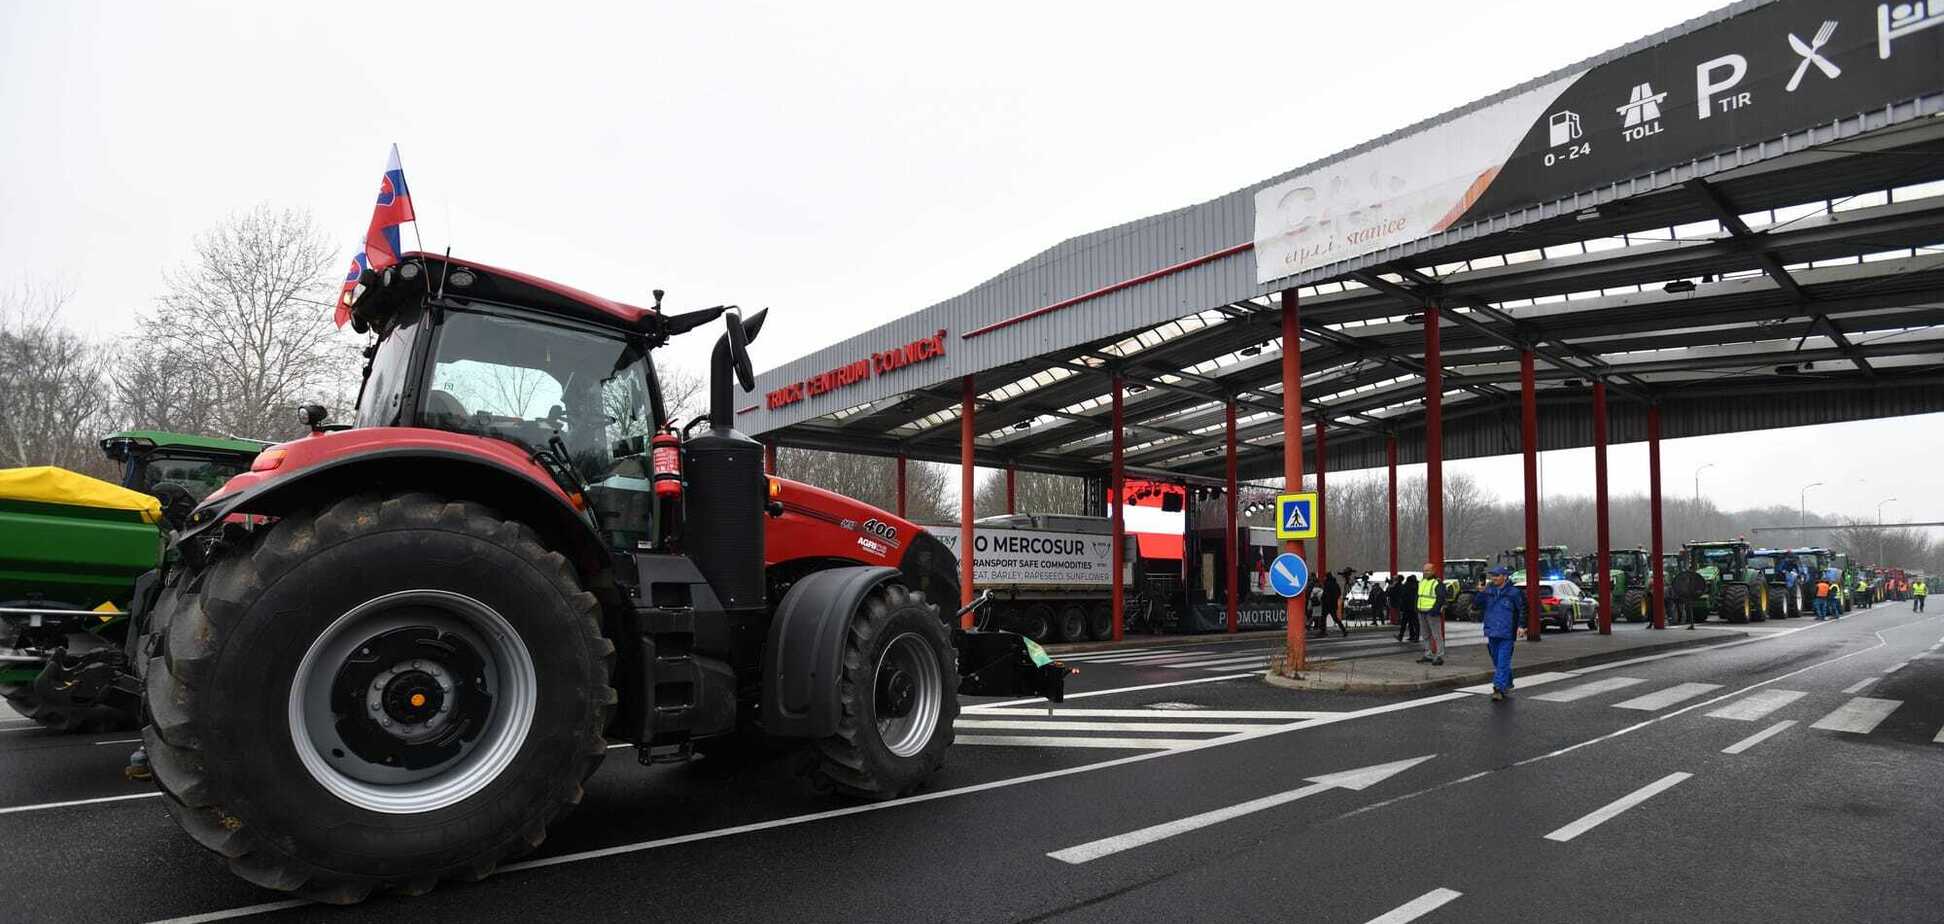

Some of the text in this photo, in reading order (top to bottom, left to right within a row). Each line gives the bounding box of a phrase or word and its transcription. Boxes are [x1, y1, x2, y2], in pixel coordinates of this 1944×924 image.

[1696, 53, 1748, 120] P
[1718, 92, 1752, 113] TIR
[1622, 121, 1664, 142] TOLL
[766, 381, 804, 411] TRUCK
[806, 358, 870, 397] CENTRUM
[863, 518, 897, 539] 400
[993, 536, 1085, 556] MERCOSUR
[973, 558, 1018, 568] RANSPORT
[1019, 559, 1039, 569] SAFE
[1040, 560, 1092, 570] COMMODITIES
[1219, 610, 1289, 624] POMOTRUC
